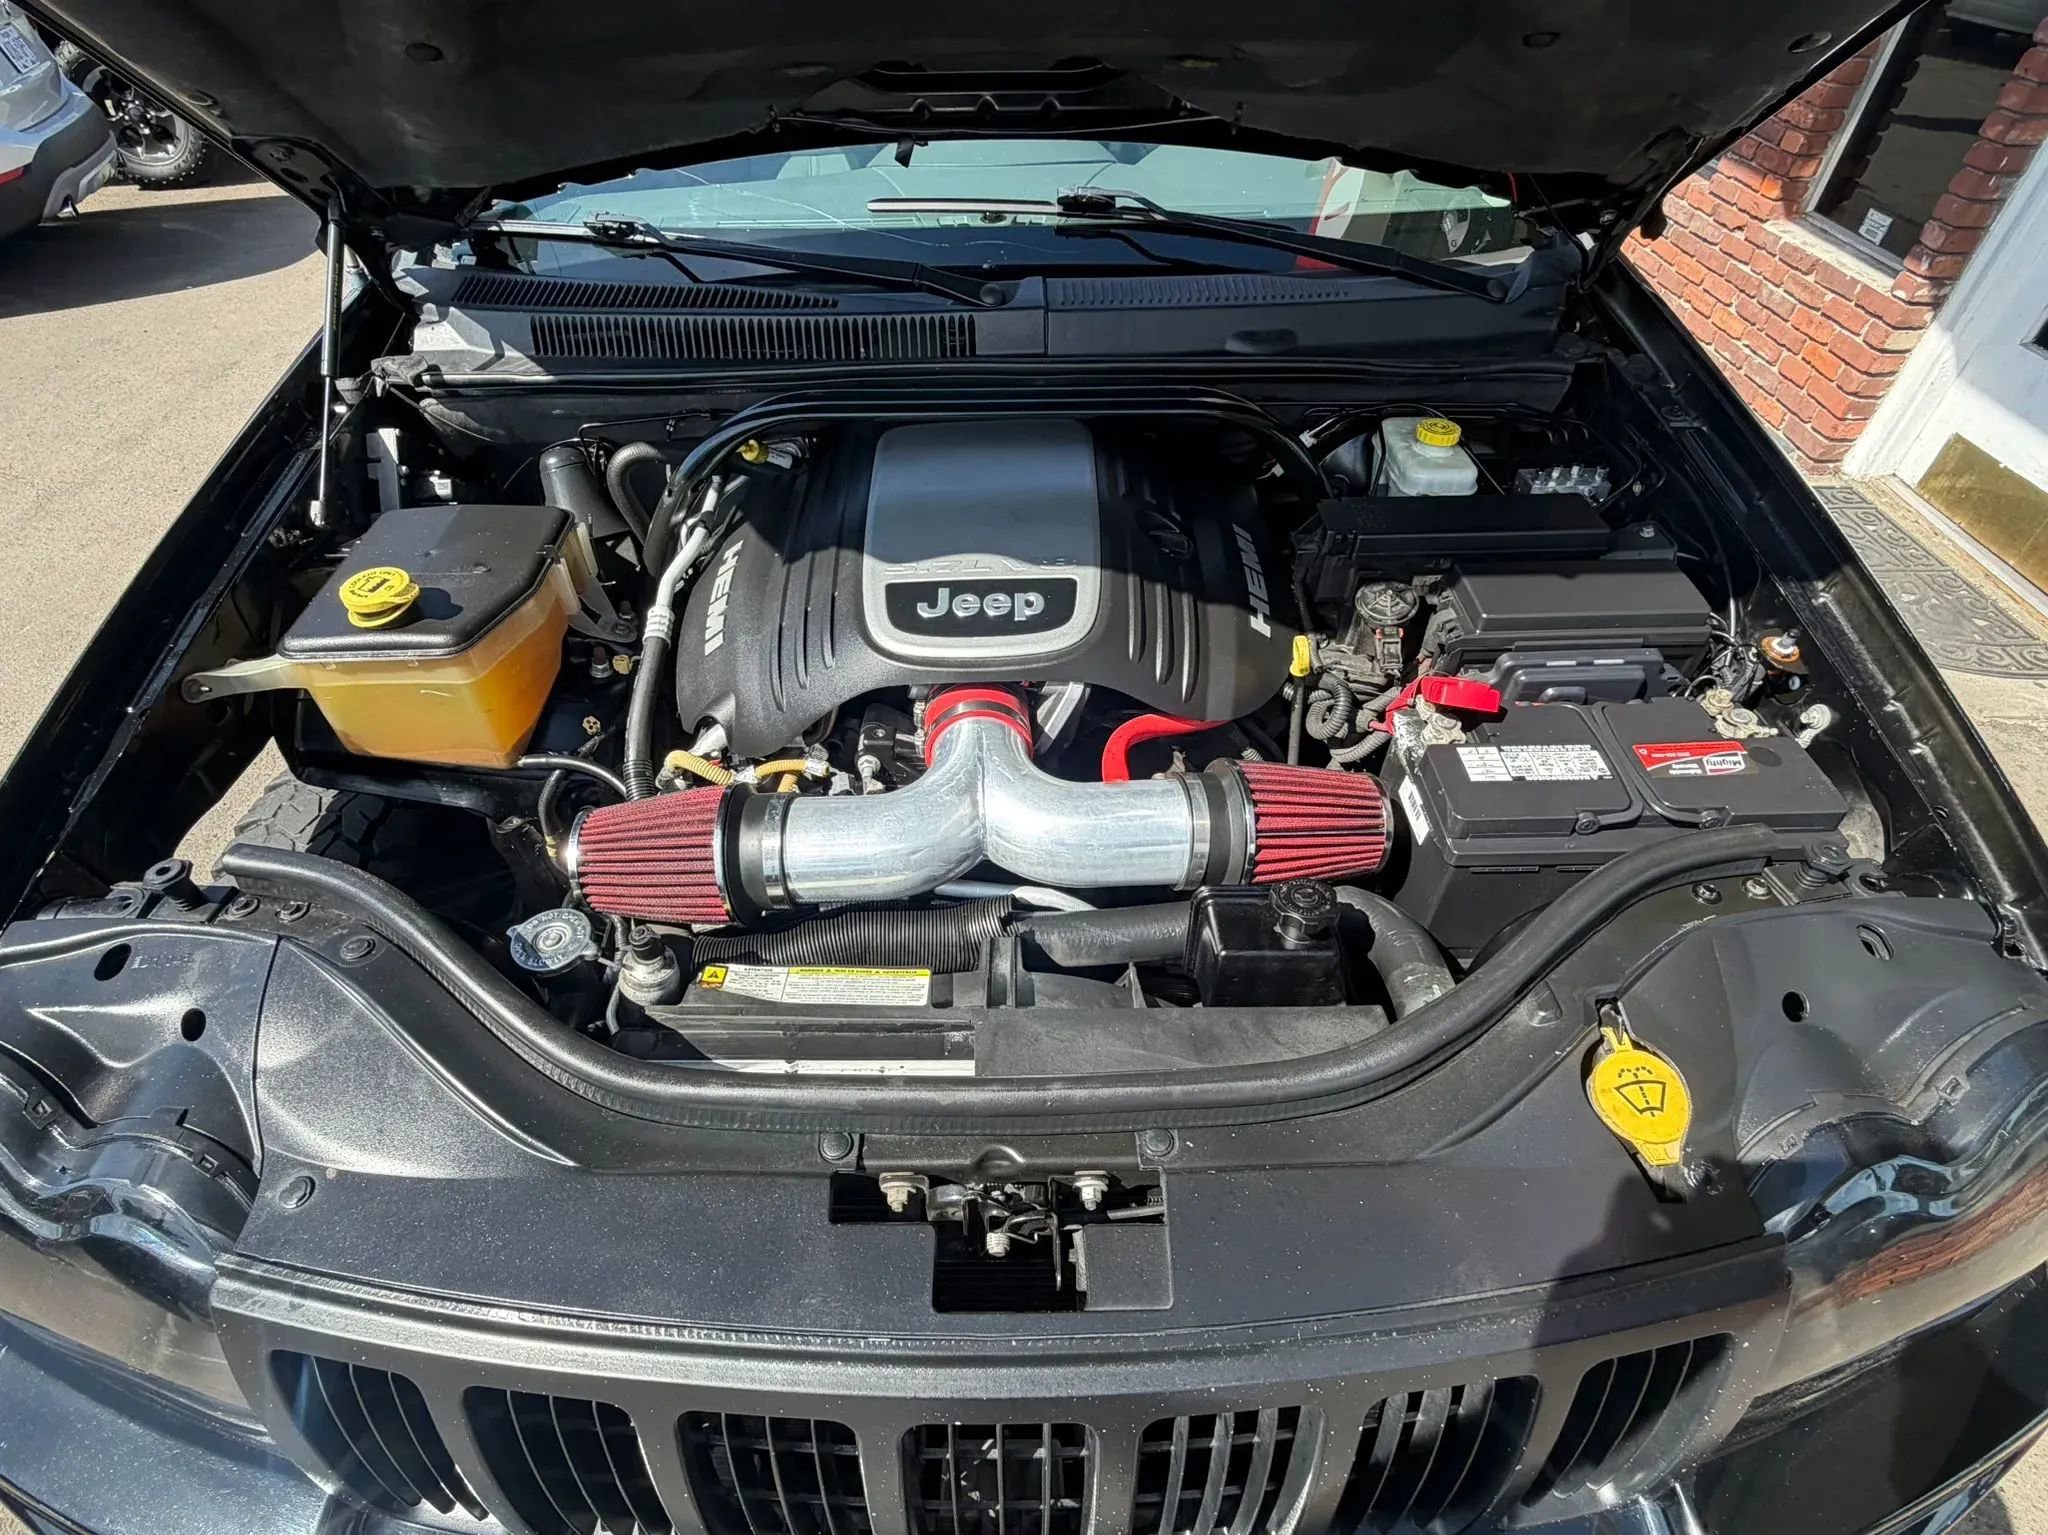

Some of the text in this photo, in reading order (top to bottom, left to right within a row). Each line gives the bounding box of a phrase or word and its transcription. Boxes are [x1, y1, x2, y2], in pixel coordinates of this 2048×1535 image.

[704, 539, 744, 656] HEMI
[1231, 523, 1271, 638] HEMI
[916, 587, 1045, 621] Jeep
[1706, 758, 1742, 768] Mighty
[541, 912, 559, 921] NOT
